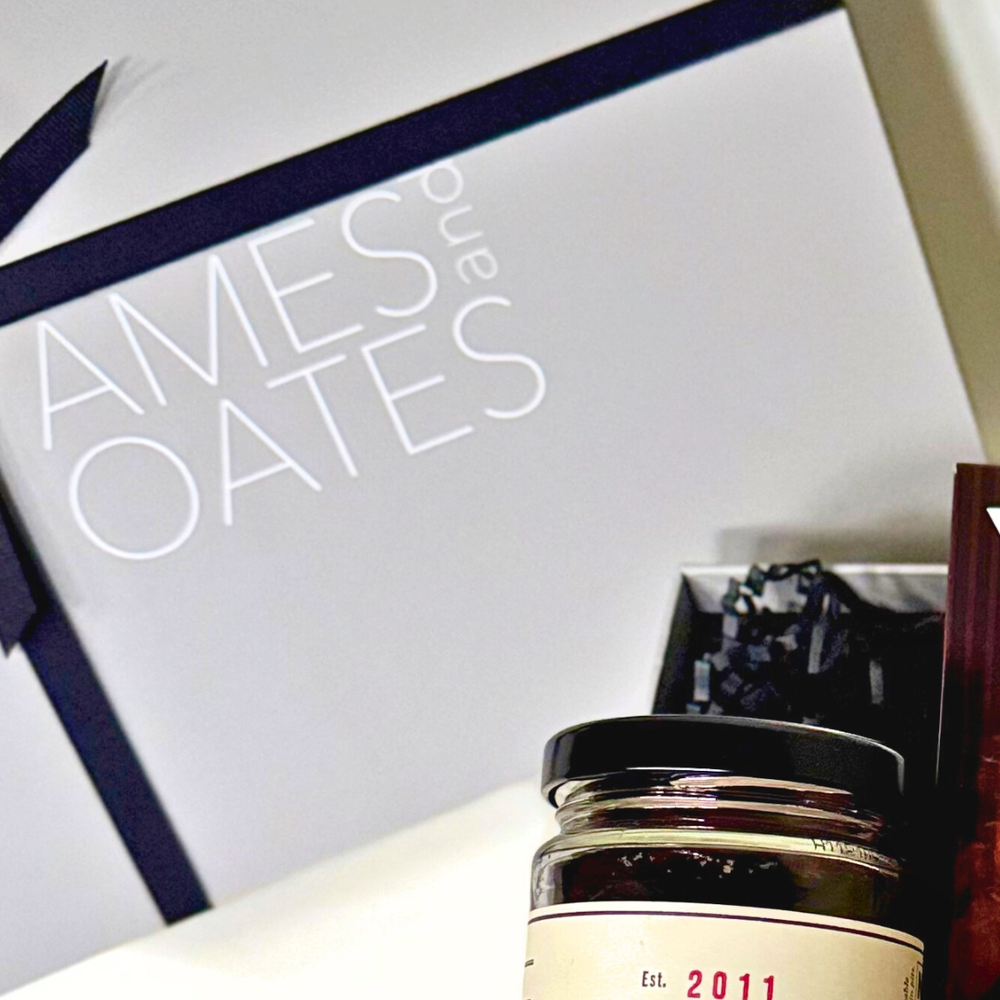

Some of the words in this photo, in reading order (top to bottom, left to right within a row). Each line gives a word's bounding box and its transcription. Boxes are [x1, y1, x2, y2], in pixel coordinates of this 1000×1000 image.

[397, 160, 498, 284] and
[37, 190, 438, 449] AMES
[69, 296, 547, 560] OATES
[641, 970, 667, 989] Est.
